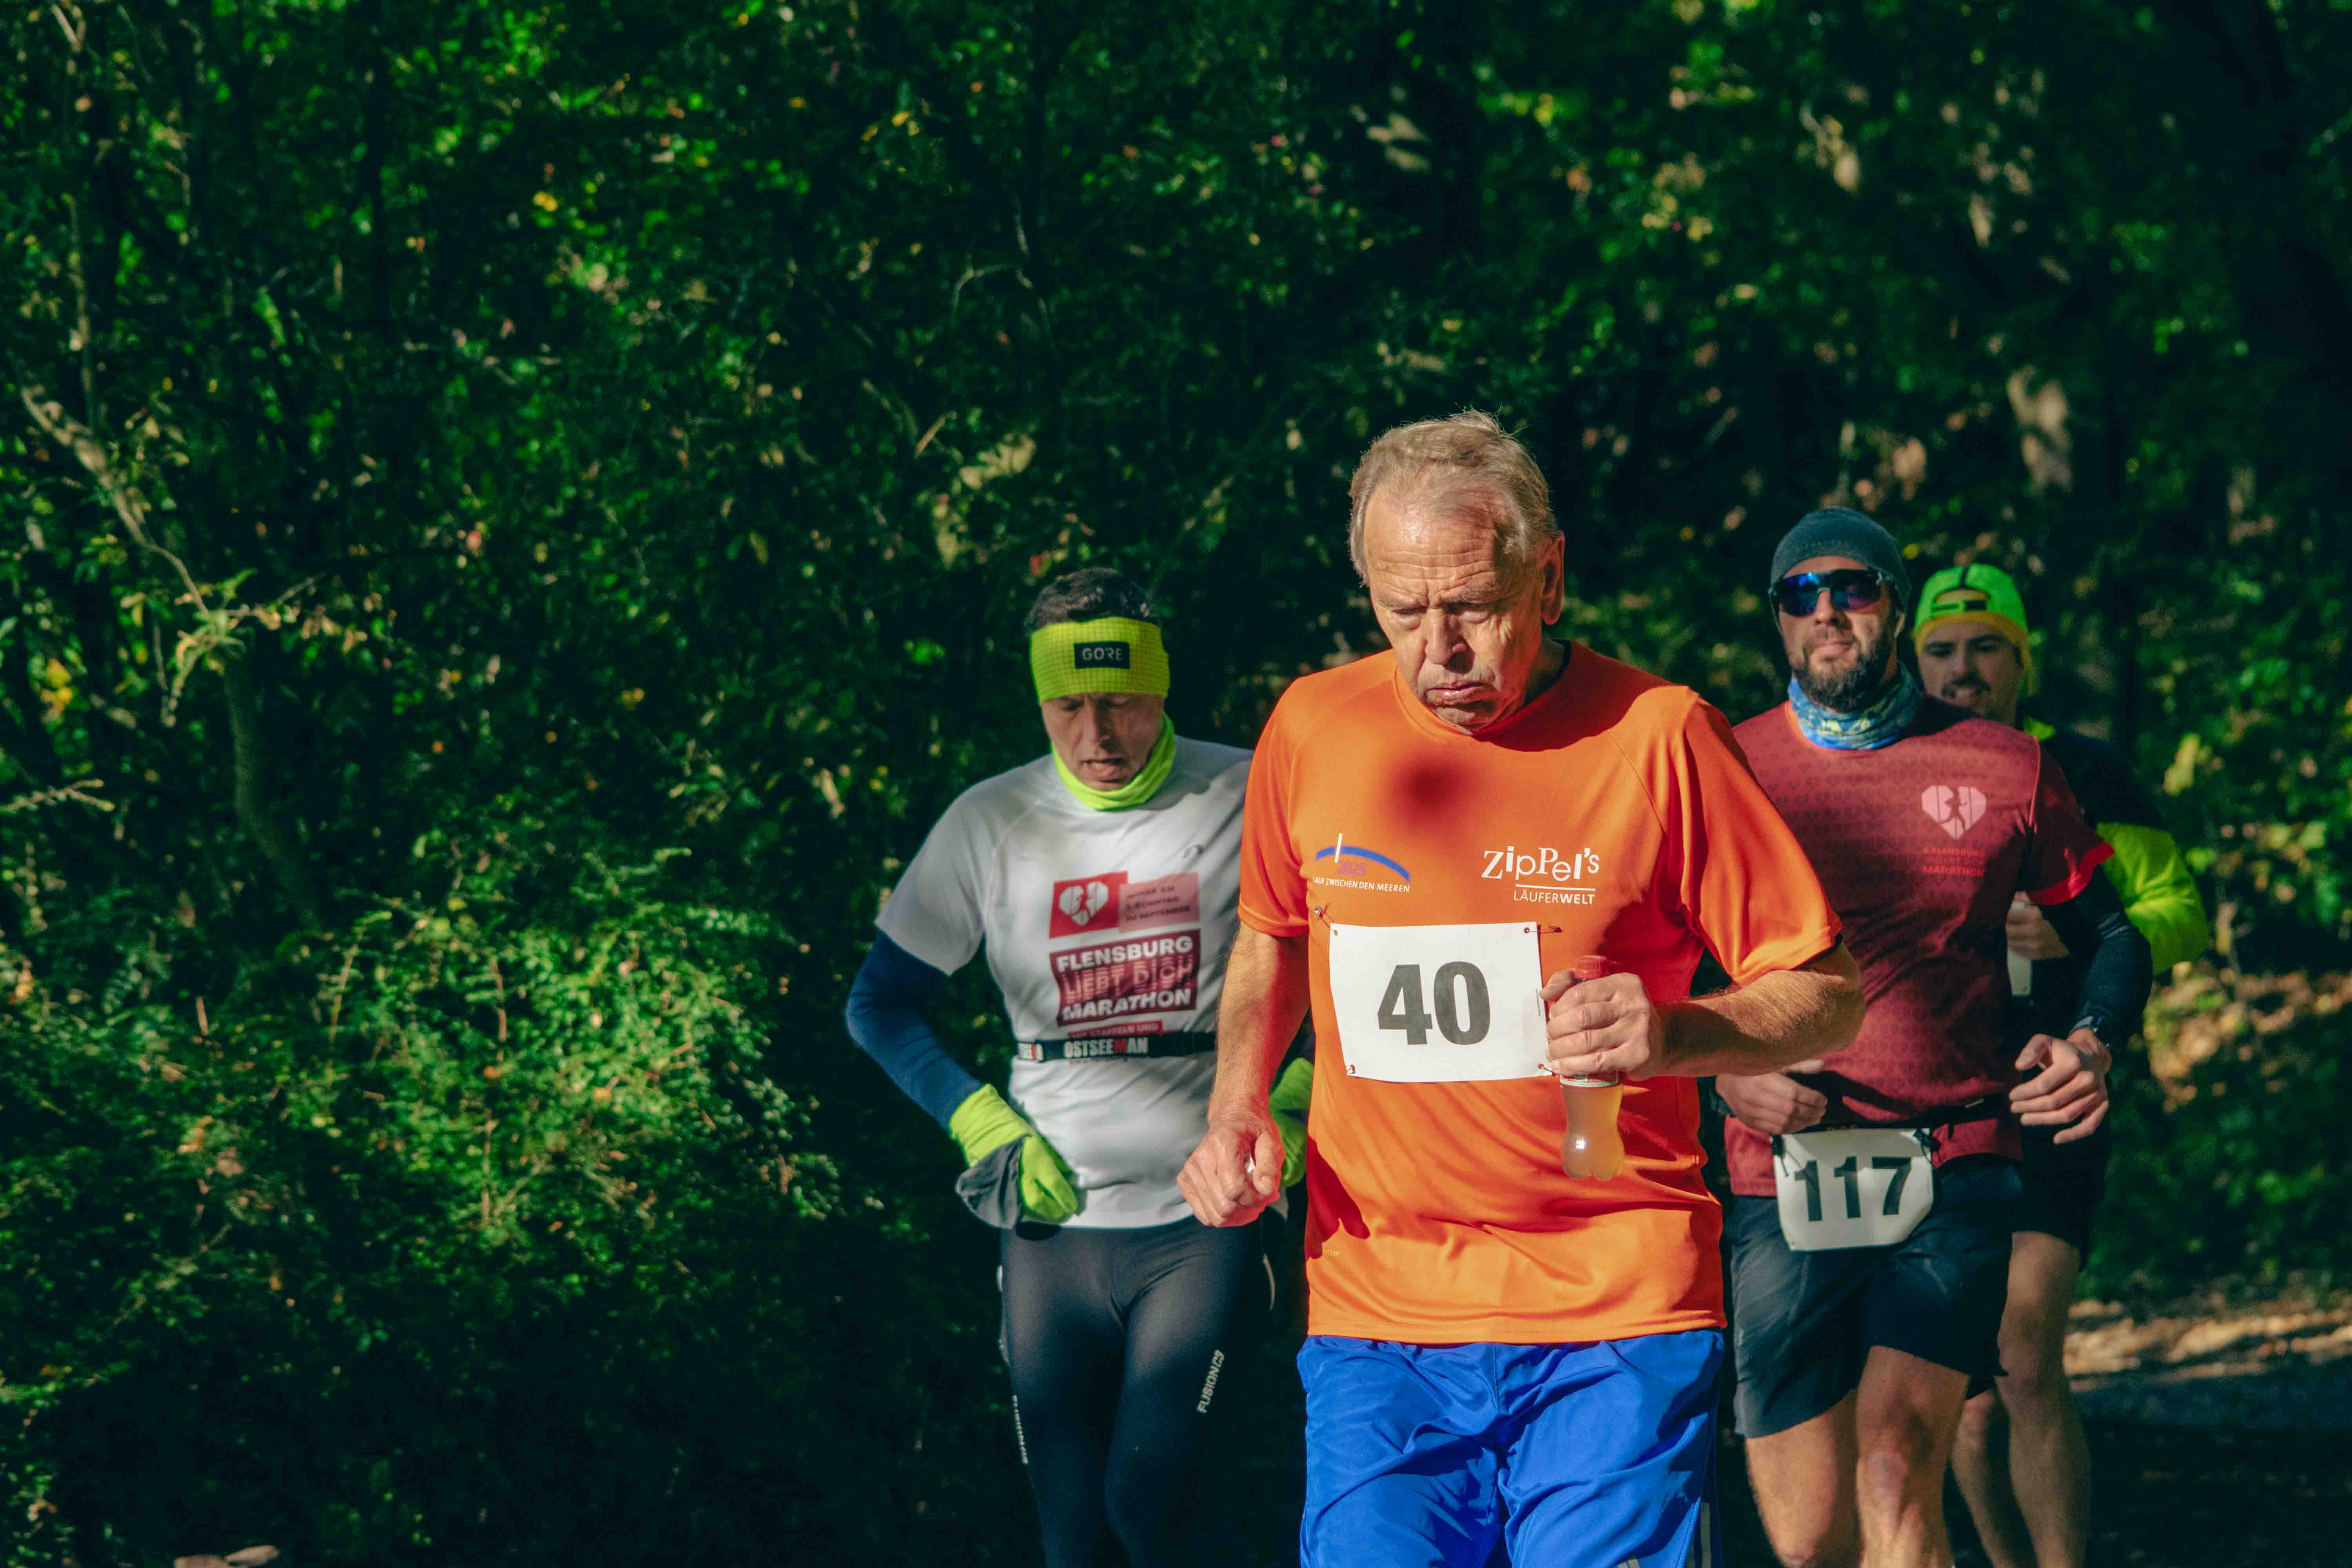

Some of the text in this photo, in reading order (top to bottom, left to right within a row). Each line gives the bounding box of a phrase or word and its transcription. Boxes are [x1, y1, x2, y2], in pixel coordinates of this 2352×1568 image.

[1082, 647, 1122, 661] GORE
[1337, 861, 1366, 877] 2025
[1922, 865, 1985, 877] MARATHON
[1313, 875, 1410, 893] LAUF ZWISCHEN DEN MEEREN
[1513, 889, 1595, 905] LÄUFERWELT
[1056, 935, 1193, 972] FLENSBURG
[1063, 954, 1193, 1005] LIEBT DICH
[1062, 988, 1191, 1020] MARATHON
[1377, 961, 1490, 1045] 40
[1063, 1037, 1149, 1059] OSTSEEMAN
[1794, 1156, 1913, 1222] 117
